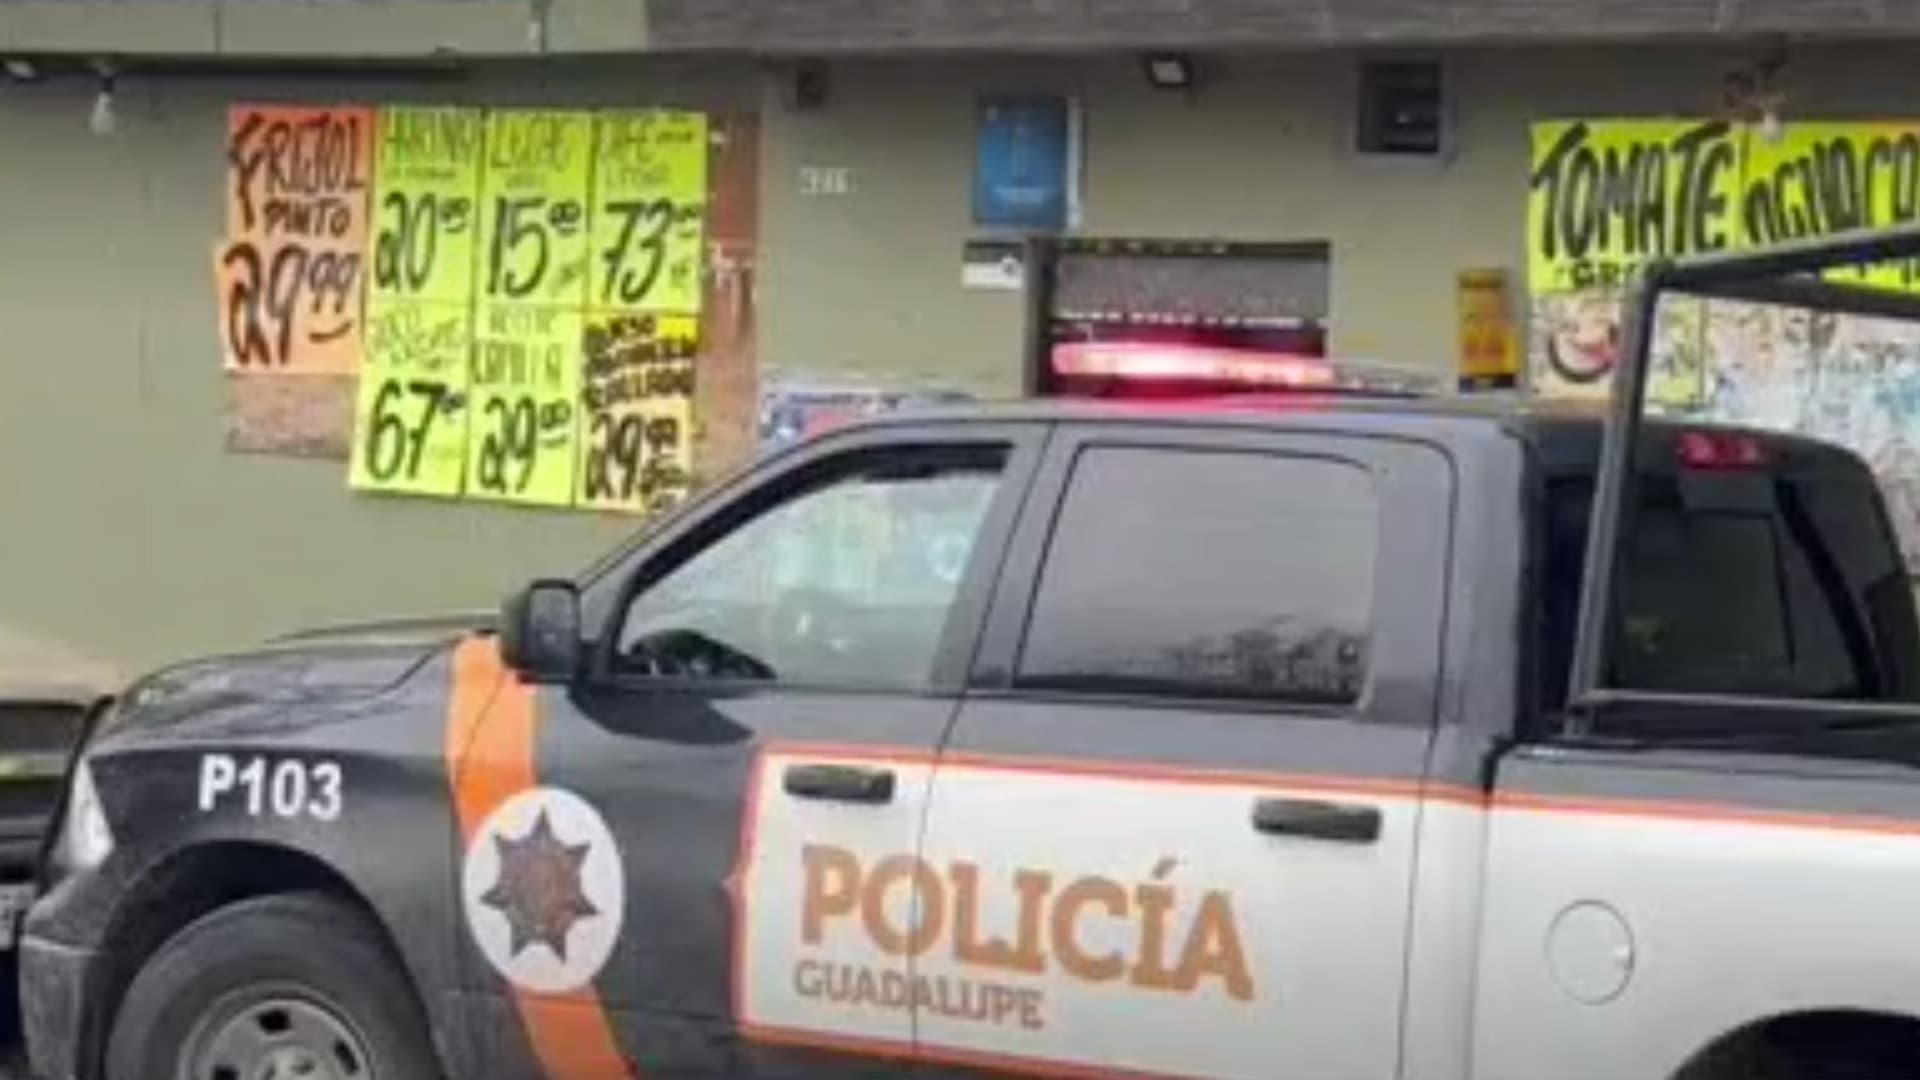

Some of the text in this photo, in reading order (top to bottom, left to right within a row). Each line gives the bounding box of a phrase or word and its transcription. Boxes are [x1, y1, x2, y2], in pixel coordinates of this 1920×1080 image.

[1531, 123, 1731, 258] TOMATE
[199, 754, 342, 819] P103
[801, 842, 1255, 1000] POLICÍA
[795, 959, 1044, 1029] GUADALUPE
